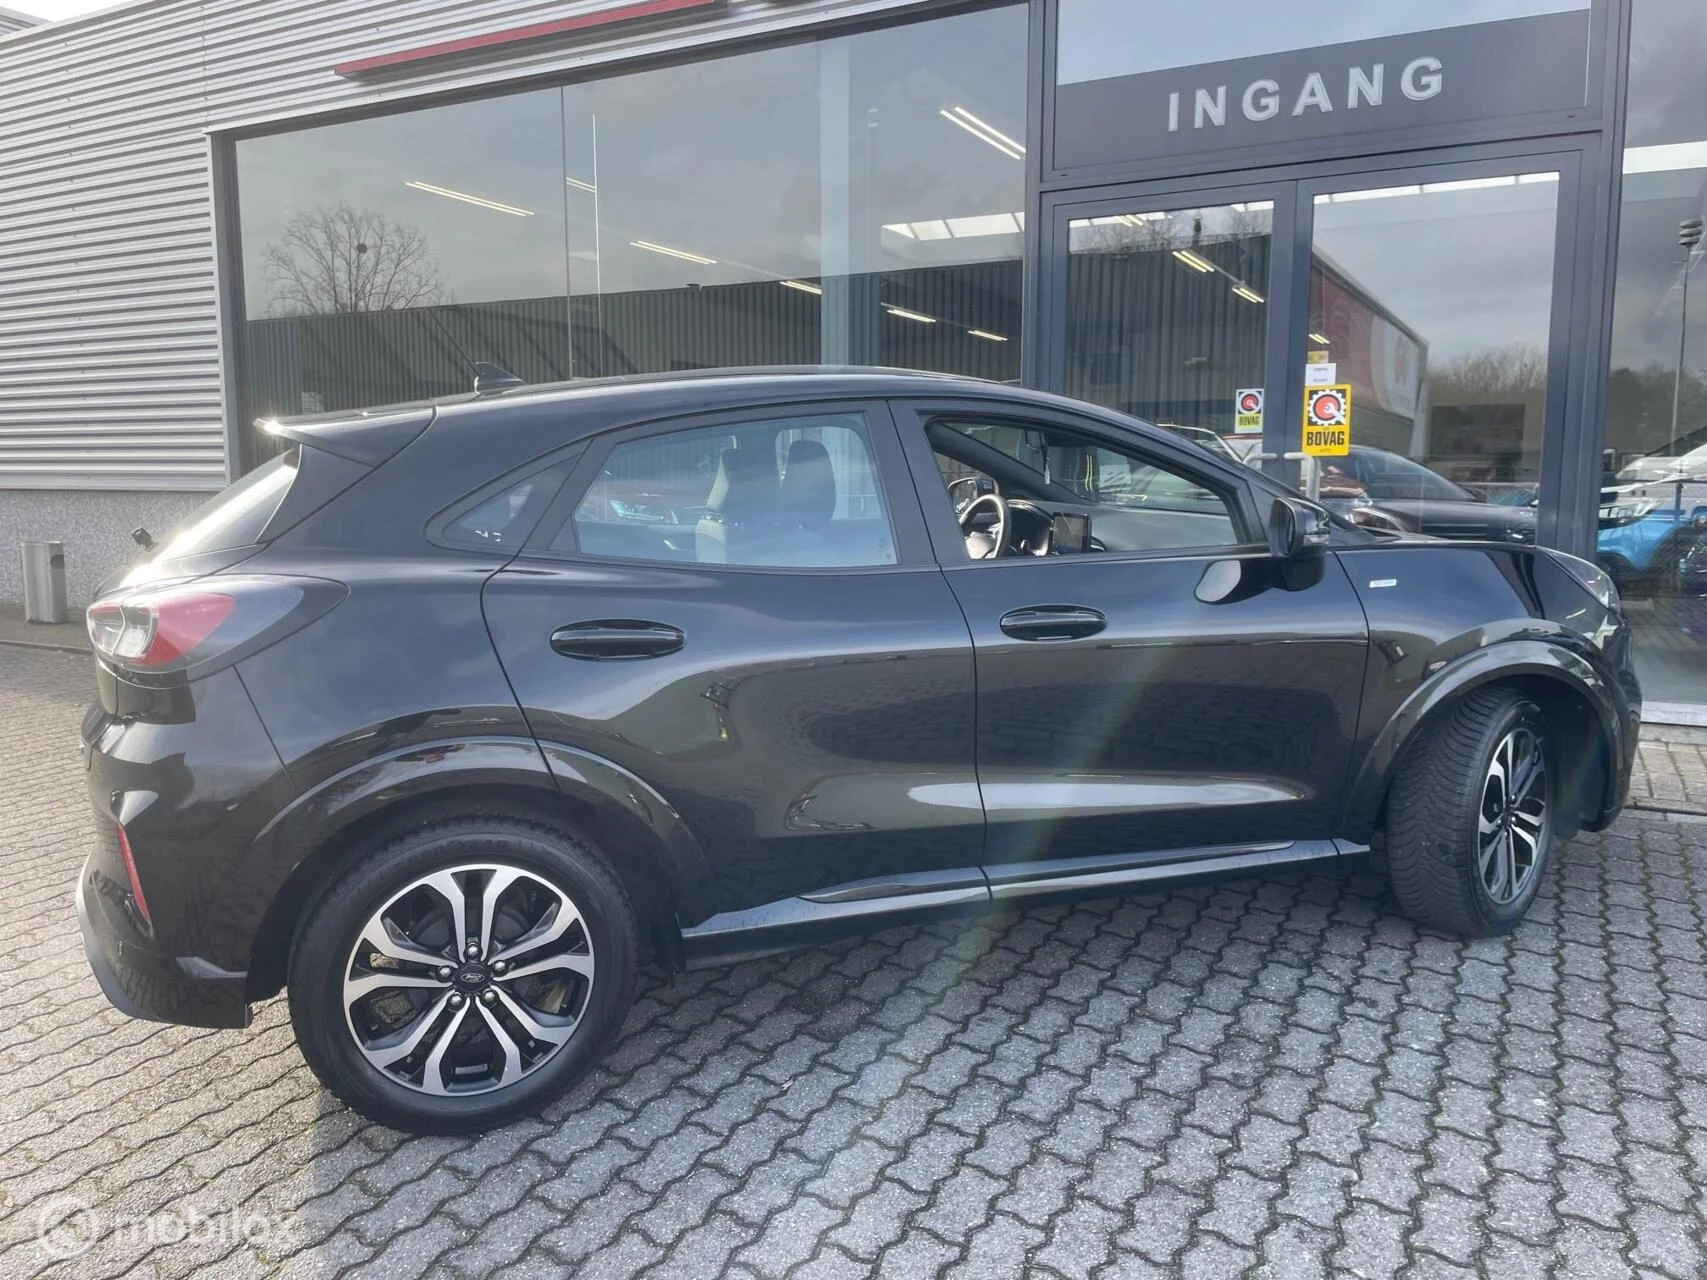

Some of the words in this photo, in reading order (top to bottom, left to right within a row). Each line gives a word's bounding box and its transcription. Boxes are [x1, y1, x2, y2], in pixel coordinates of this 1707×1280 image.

[1168, 56, 1443, 132] INGANG
[1238, 416, 1260, 426] BOVAG
[1306, 431, 1345, 446] BOVAG
